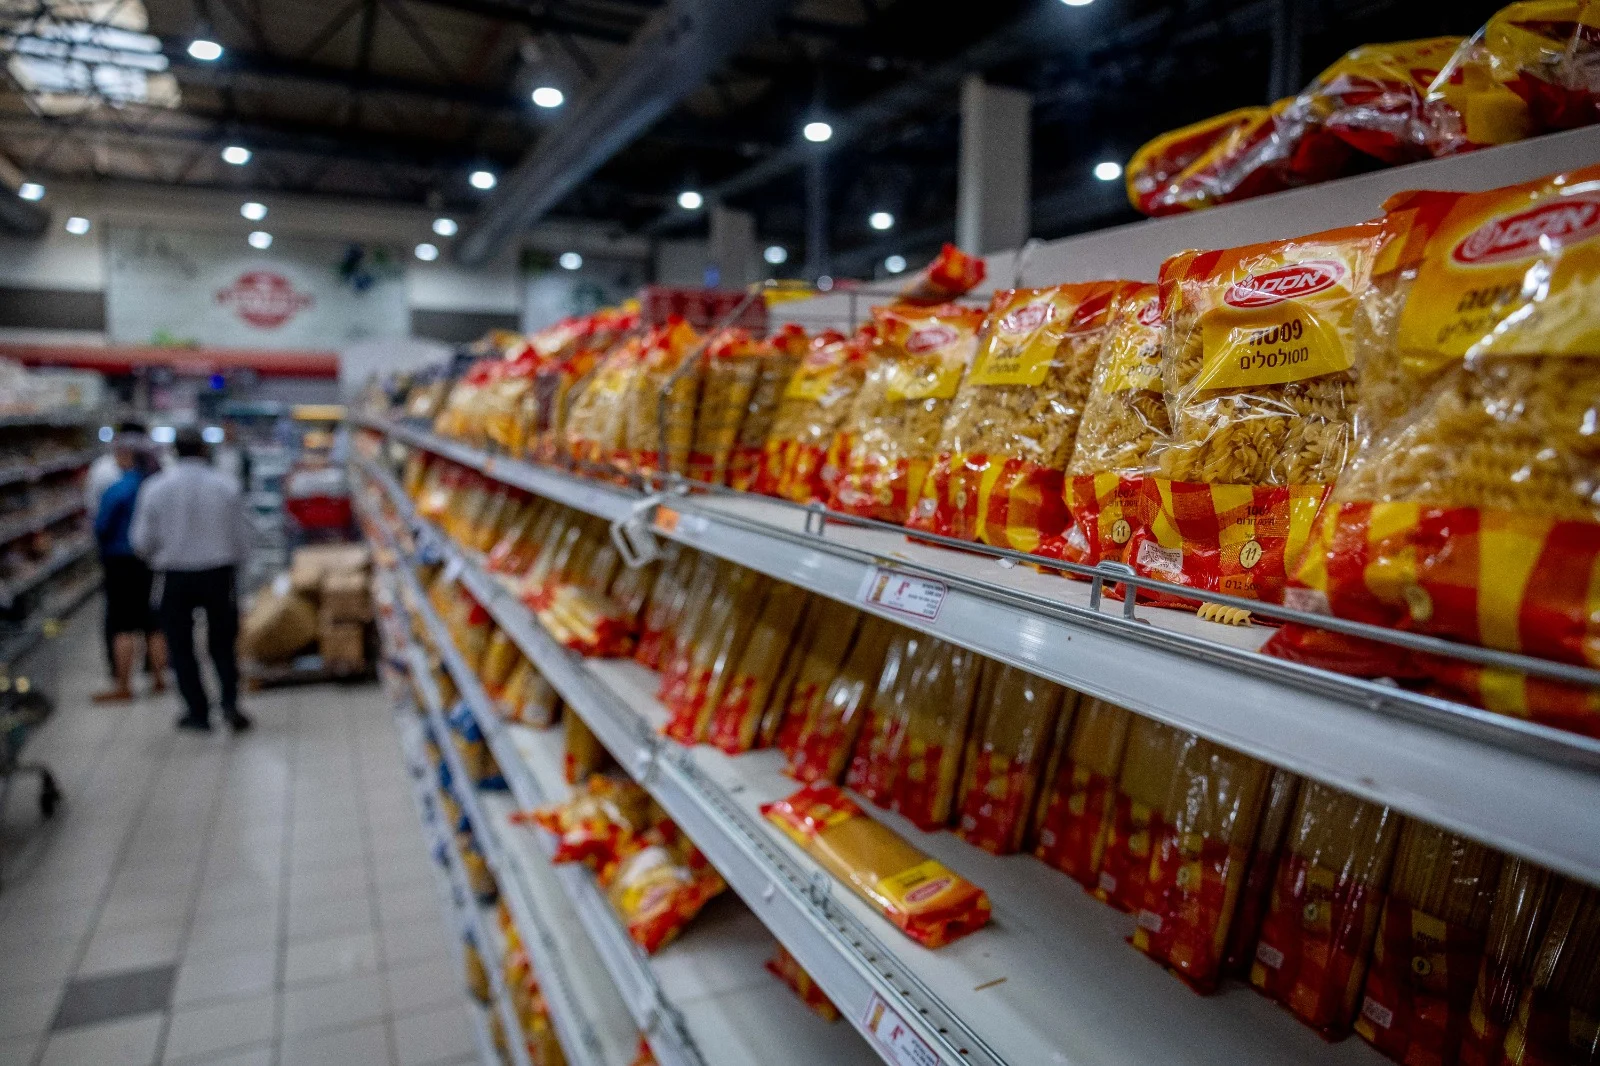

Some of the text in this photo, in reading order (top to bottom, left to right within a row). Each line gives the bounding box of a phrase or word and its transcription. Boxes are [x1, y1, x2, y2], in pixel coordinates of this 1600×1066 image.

[1260, 269, 1322, 294] אסם
[1249, 318, 1304, 347] פסטה
[1240, 346, 1309, 370] מסולסלים
[1116, 525, 1126, 537] 11
[1245, 547, 1257, 560] 11
